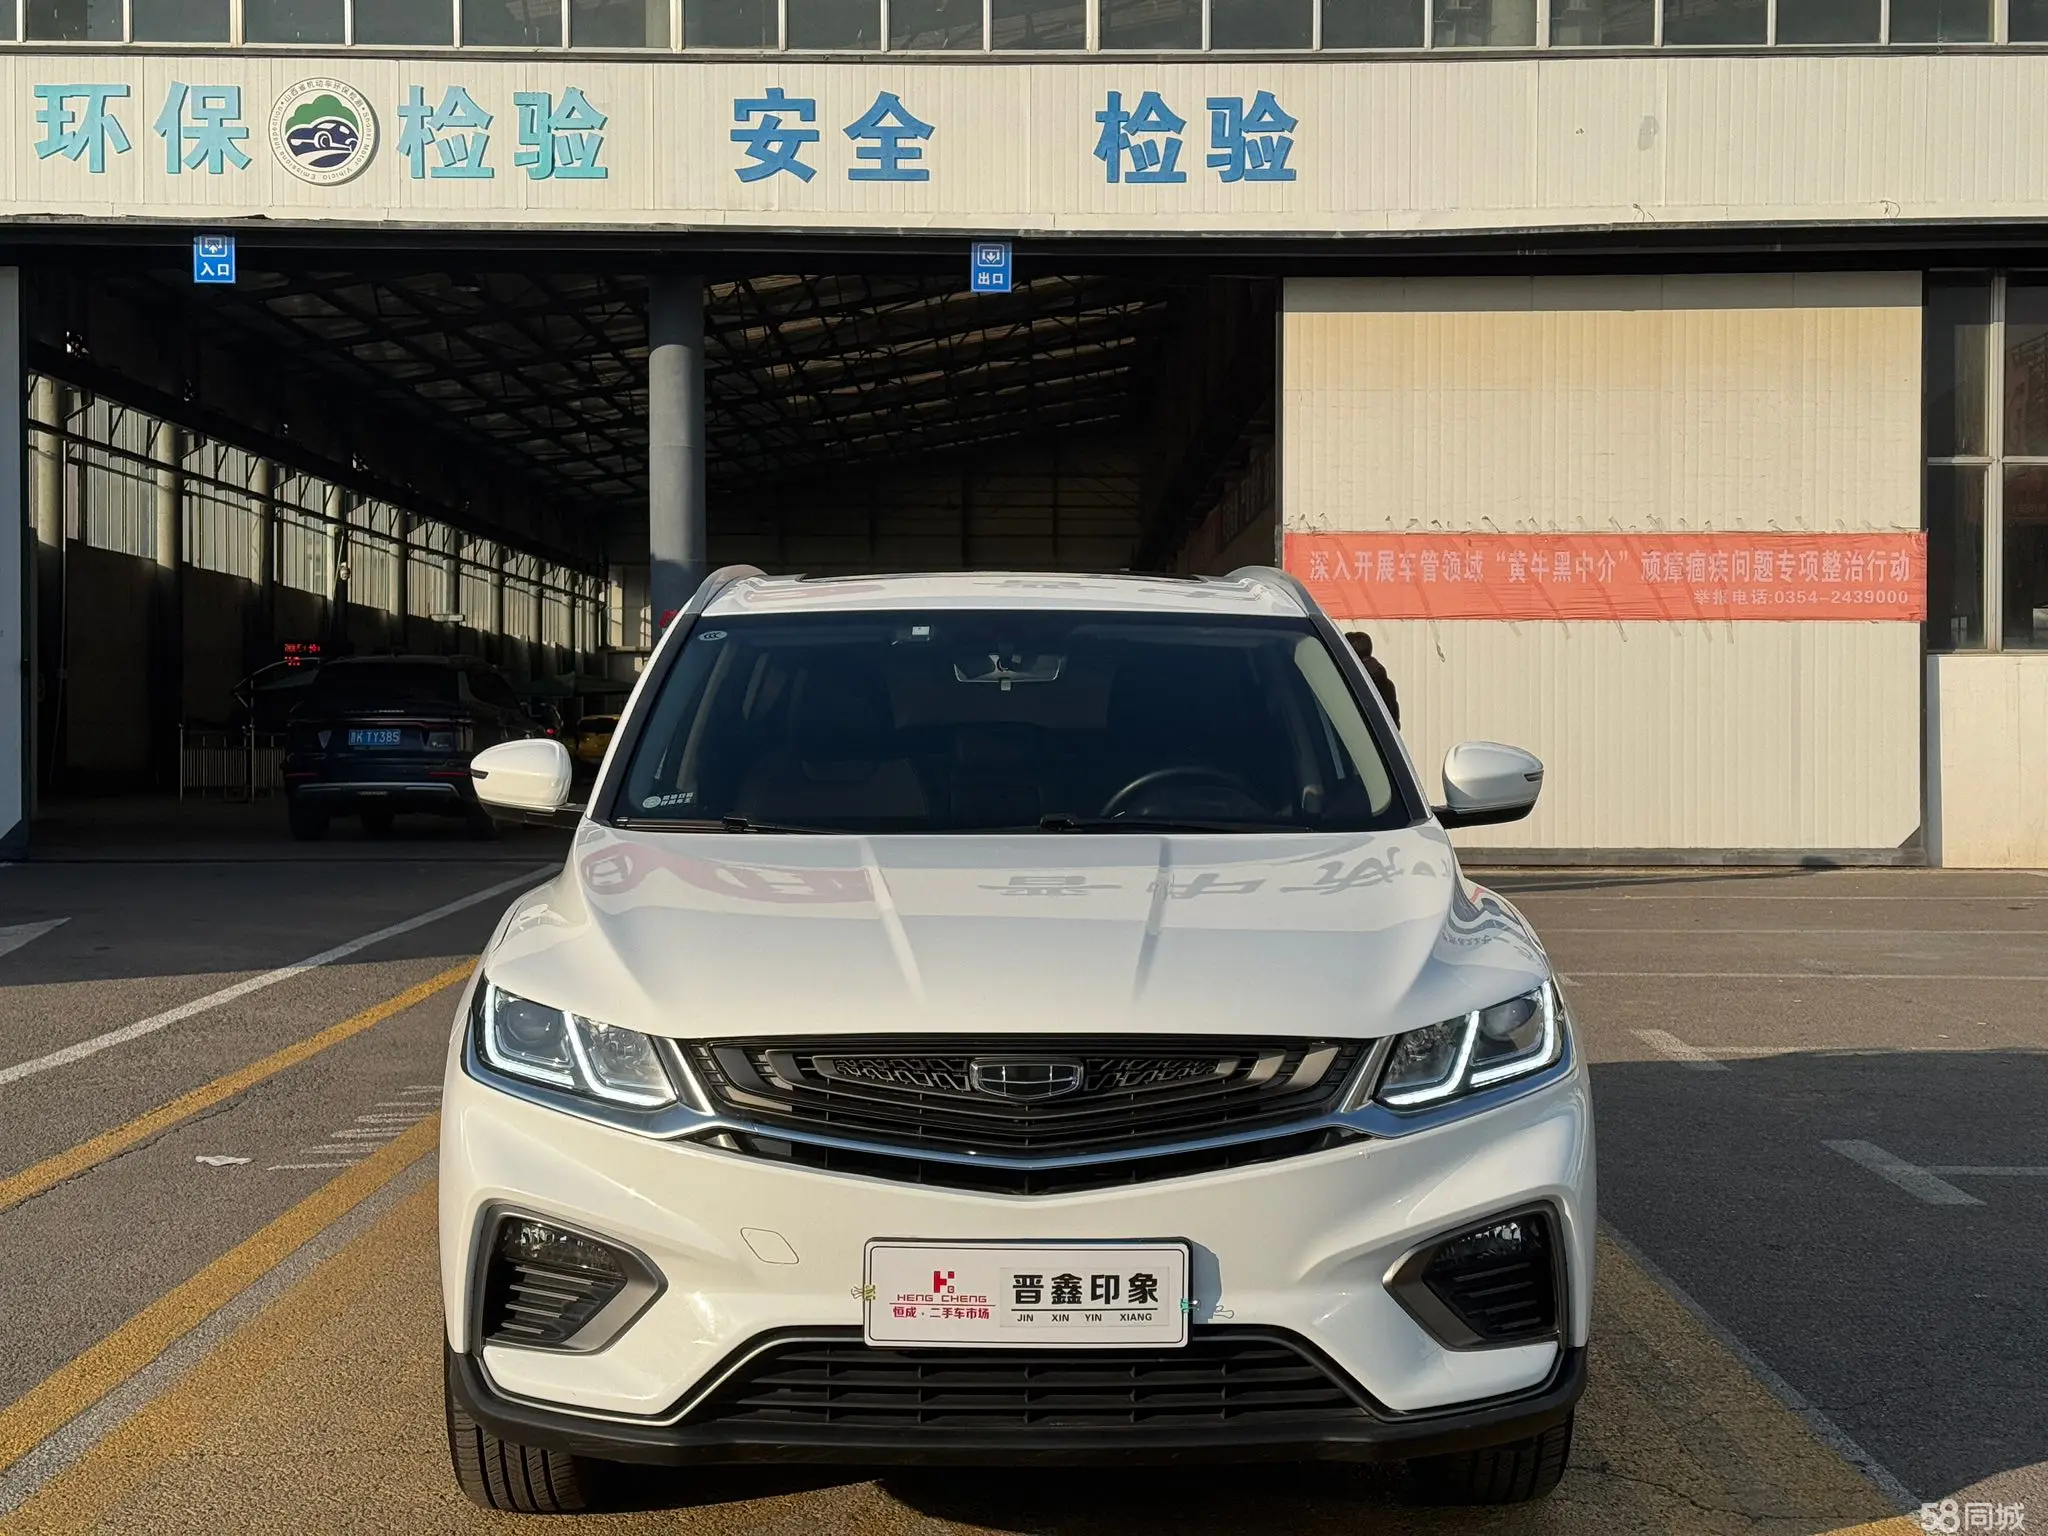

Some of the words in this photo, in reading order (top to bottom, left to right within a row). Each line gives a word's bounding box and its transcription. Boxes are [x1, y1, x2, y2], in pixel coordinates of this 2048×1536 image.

[33, 81, 252, 175] 环保
[397, 84, 609, 180] 检验
[730, 87, 936, 183] 安全
[1094, 90, 1299, 183] 检验
[200, 262, 229, 276] 入口
[978, 271, 1003, 285] 出口
[1013, 1273, 1158, 1304] 晋鑫印象
[897, 1294, 933, 1302] HENG
[941, 1295, 987, 1303] CHENG
[1017, 1314, 1034, 1322] JIN
[1051, 1314, 1070, 1322] XIN
[1085, 1314, 1102, 1322] YIN
[1120, 1313, 1152, 1322] XIANG
